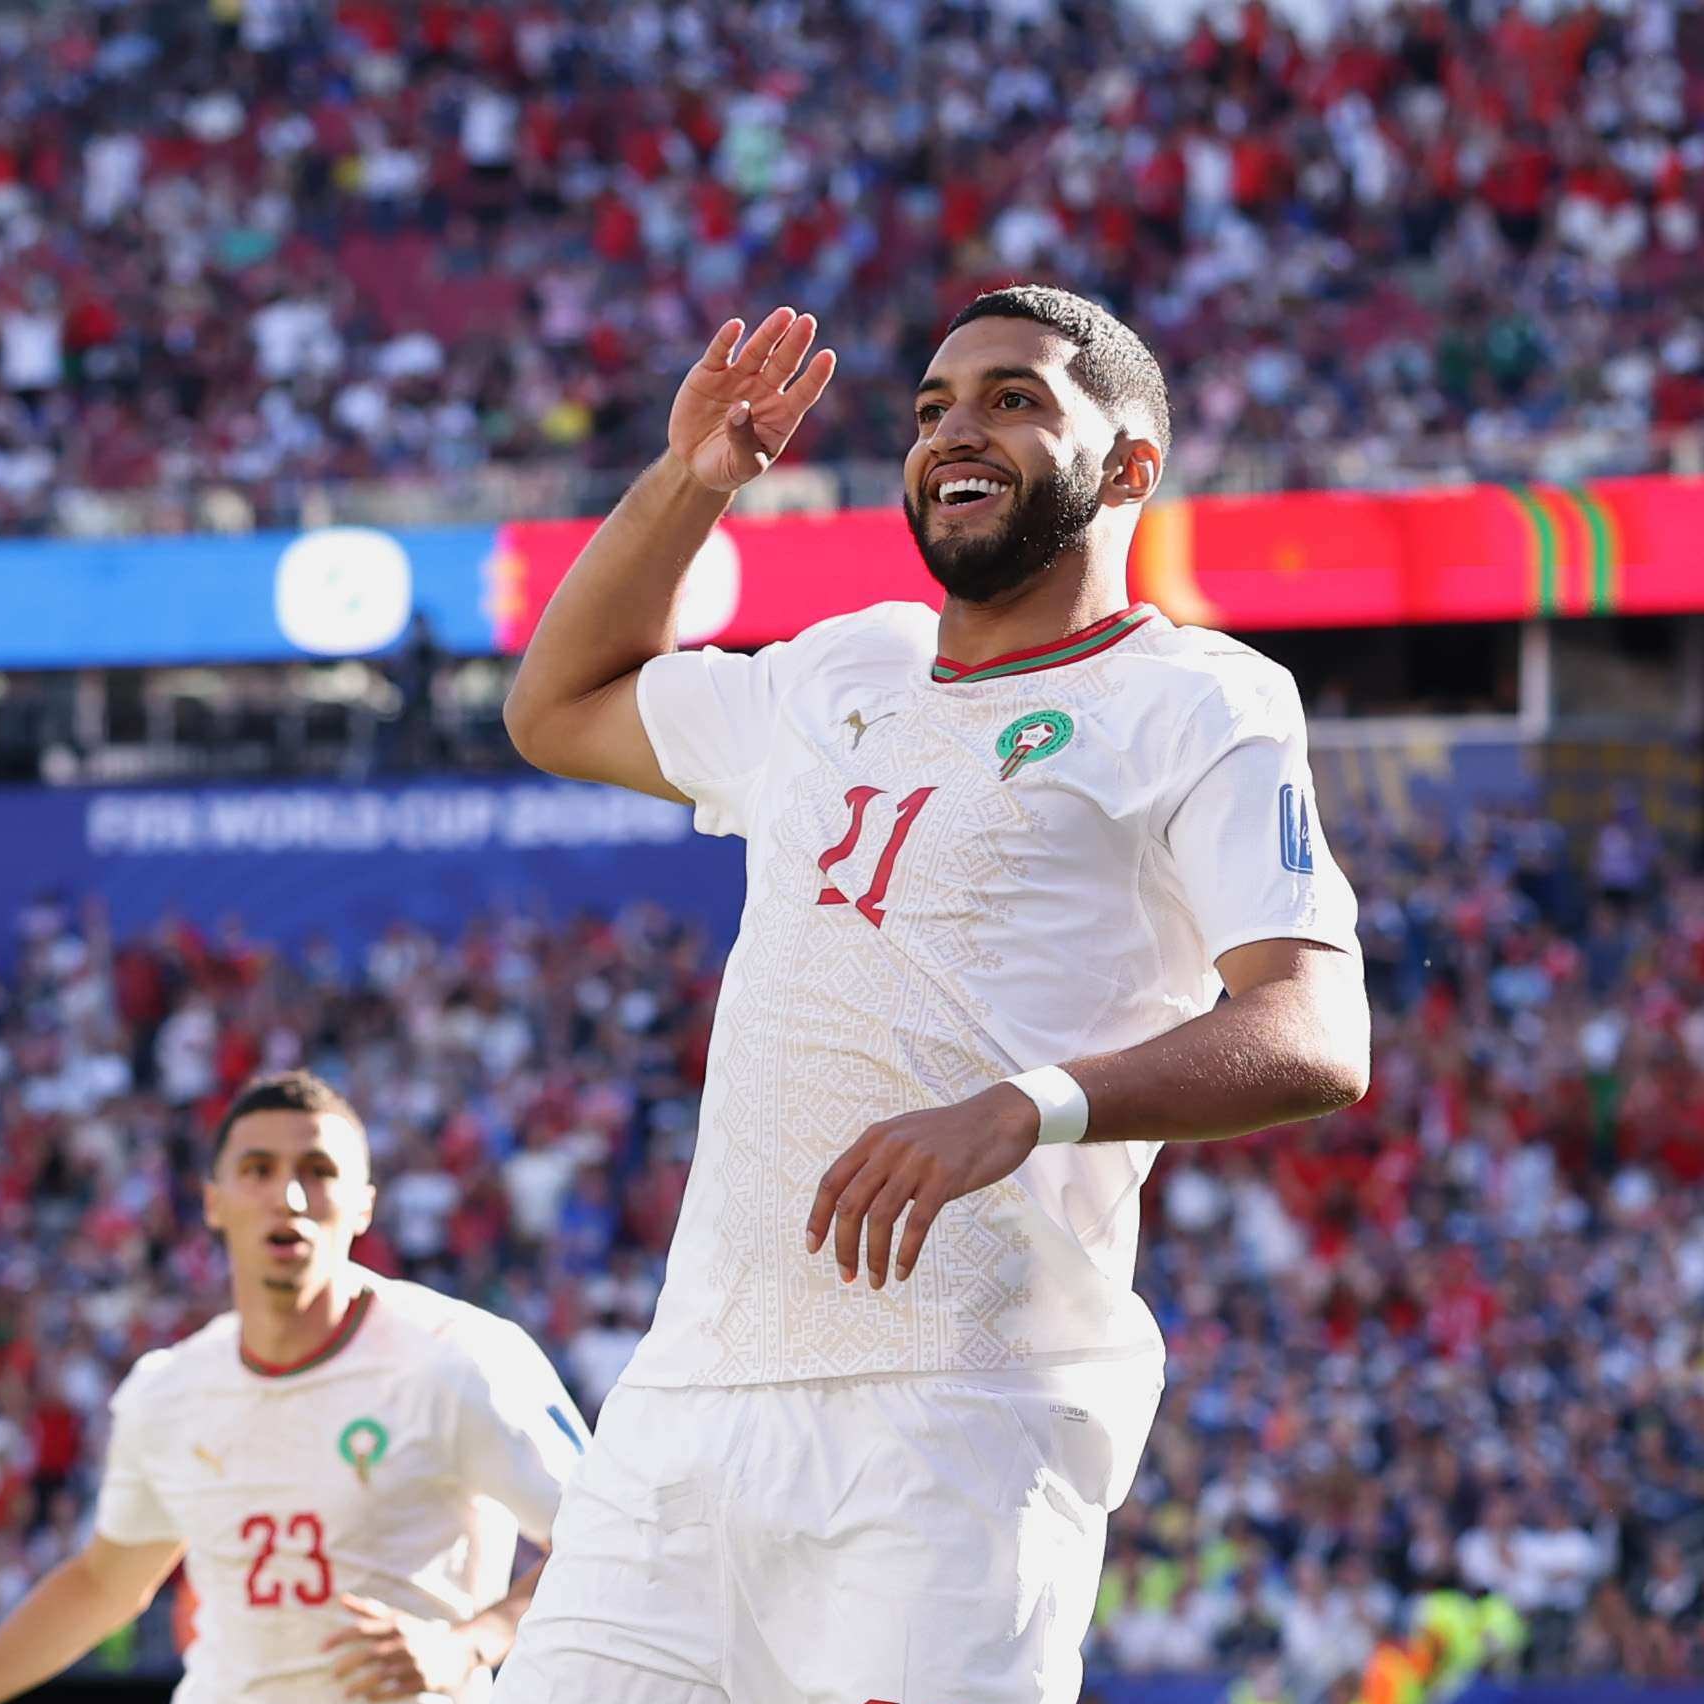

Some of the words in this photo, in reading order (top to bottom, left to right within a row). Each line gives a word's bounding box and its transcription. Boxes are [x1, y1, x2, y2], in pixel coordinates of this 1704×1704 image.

[87, 795, 194, 855] FIFA
[205, 791, 389, 853] WORLD
[395, 790, 497, 852] CUP
[240, 1511, 333, 1607] 23
